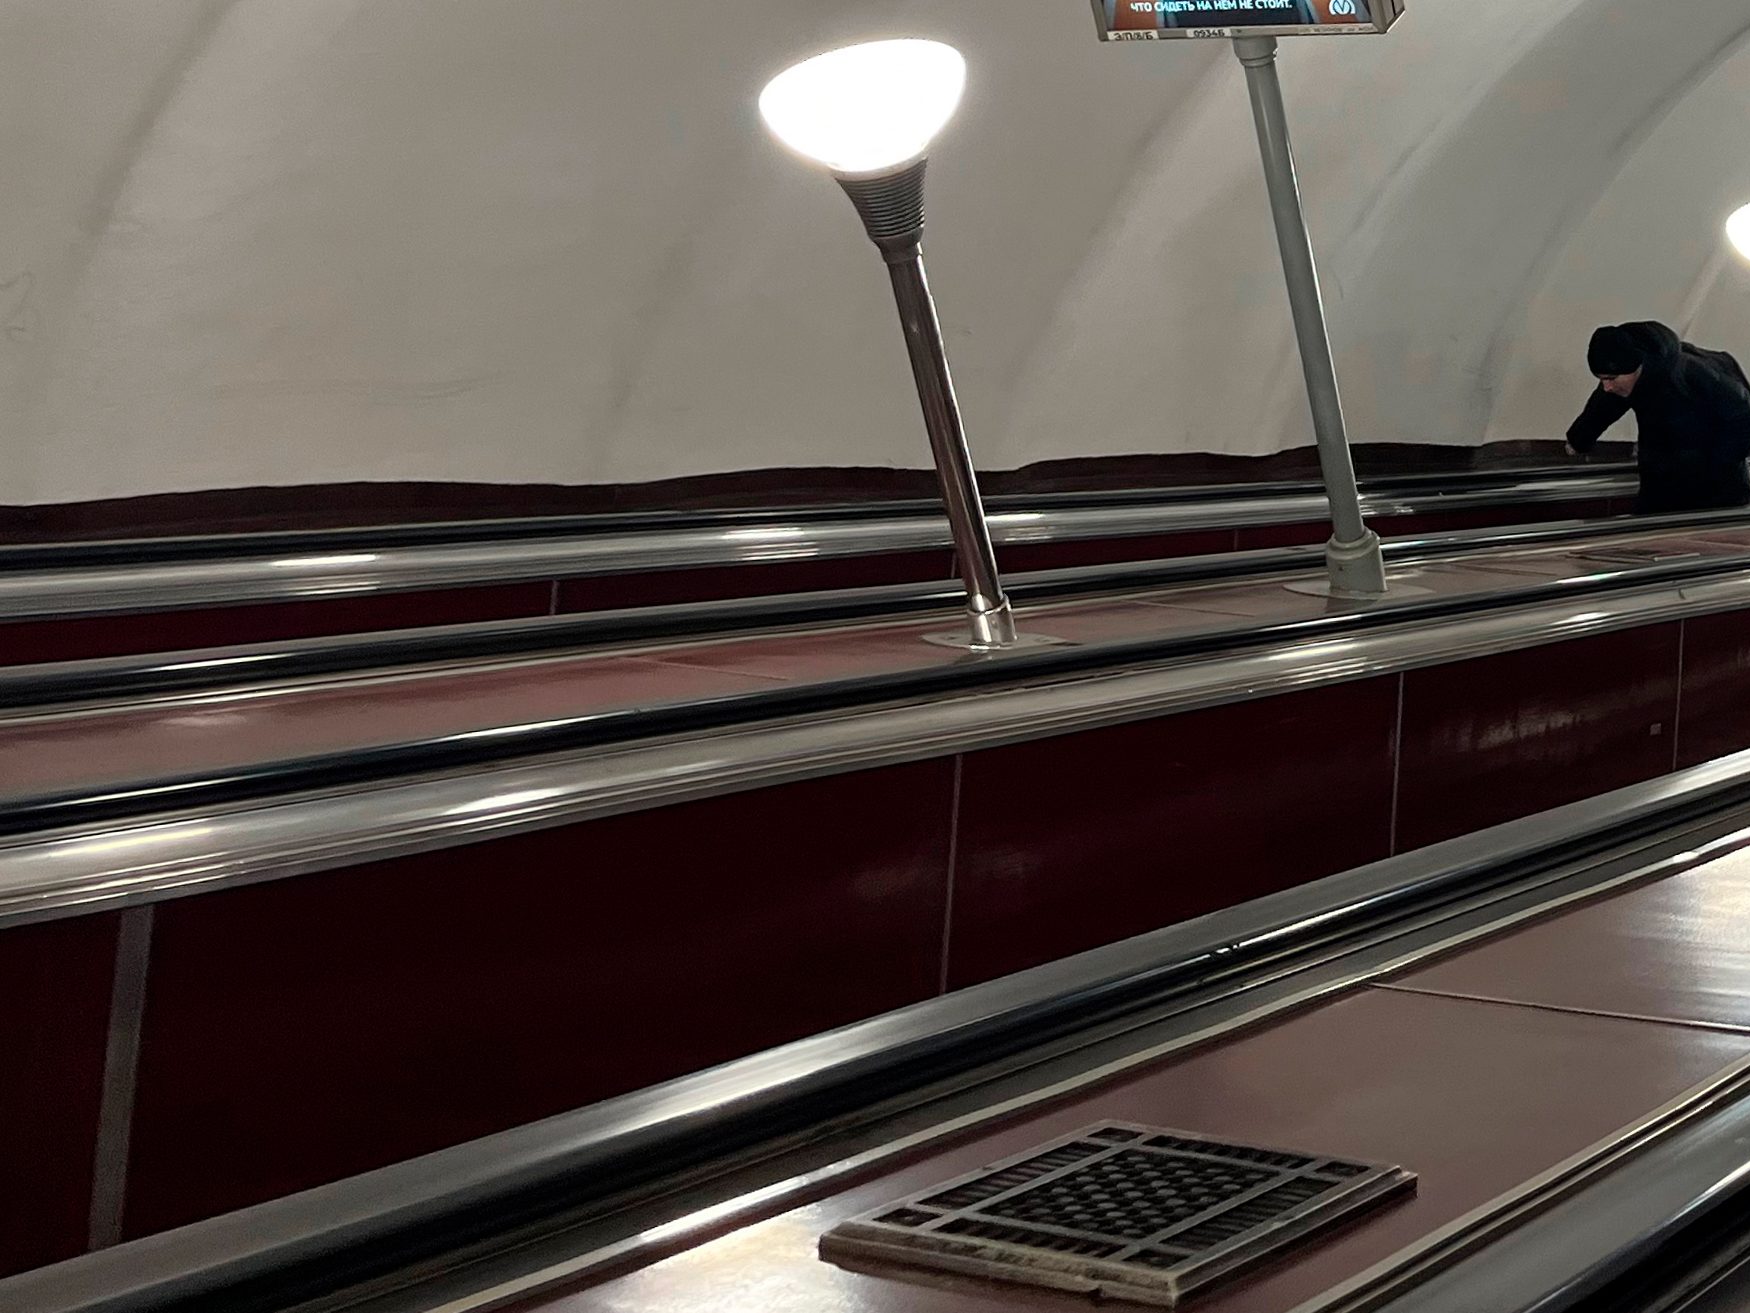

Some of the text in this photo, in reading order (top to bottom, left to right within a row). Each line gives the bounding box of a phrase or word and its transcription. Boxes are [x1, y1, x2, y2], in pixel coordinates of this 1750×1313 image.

[1130, 2, 1153, 12] ЧТО
[1154, 1, 1195, 12] СИДЕТЬ
[1197, 0, 1212, 10] НА
[1239, 0, 1253, 9] НЕ
